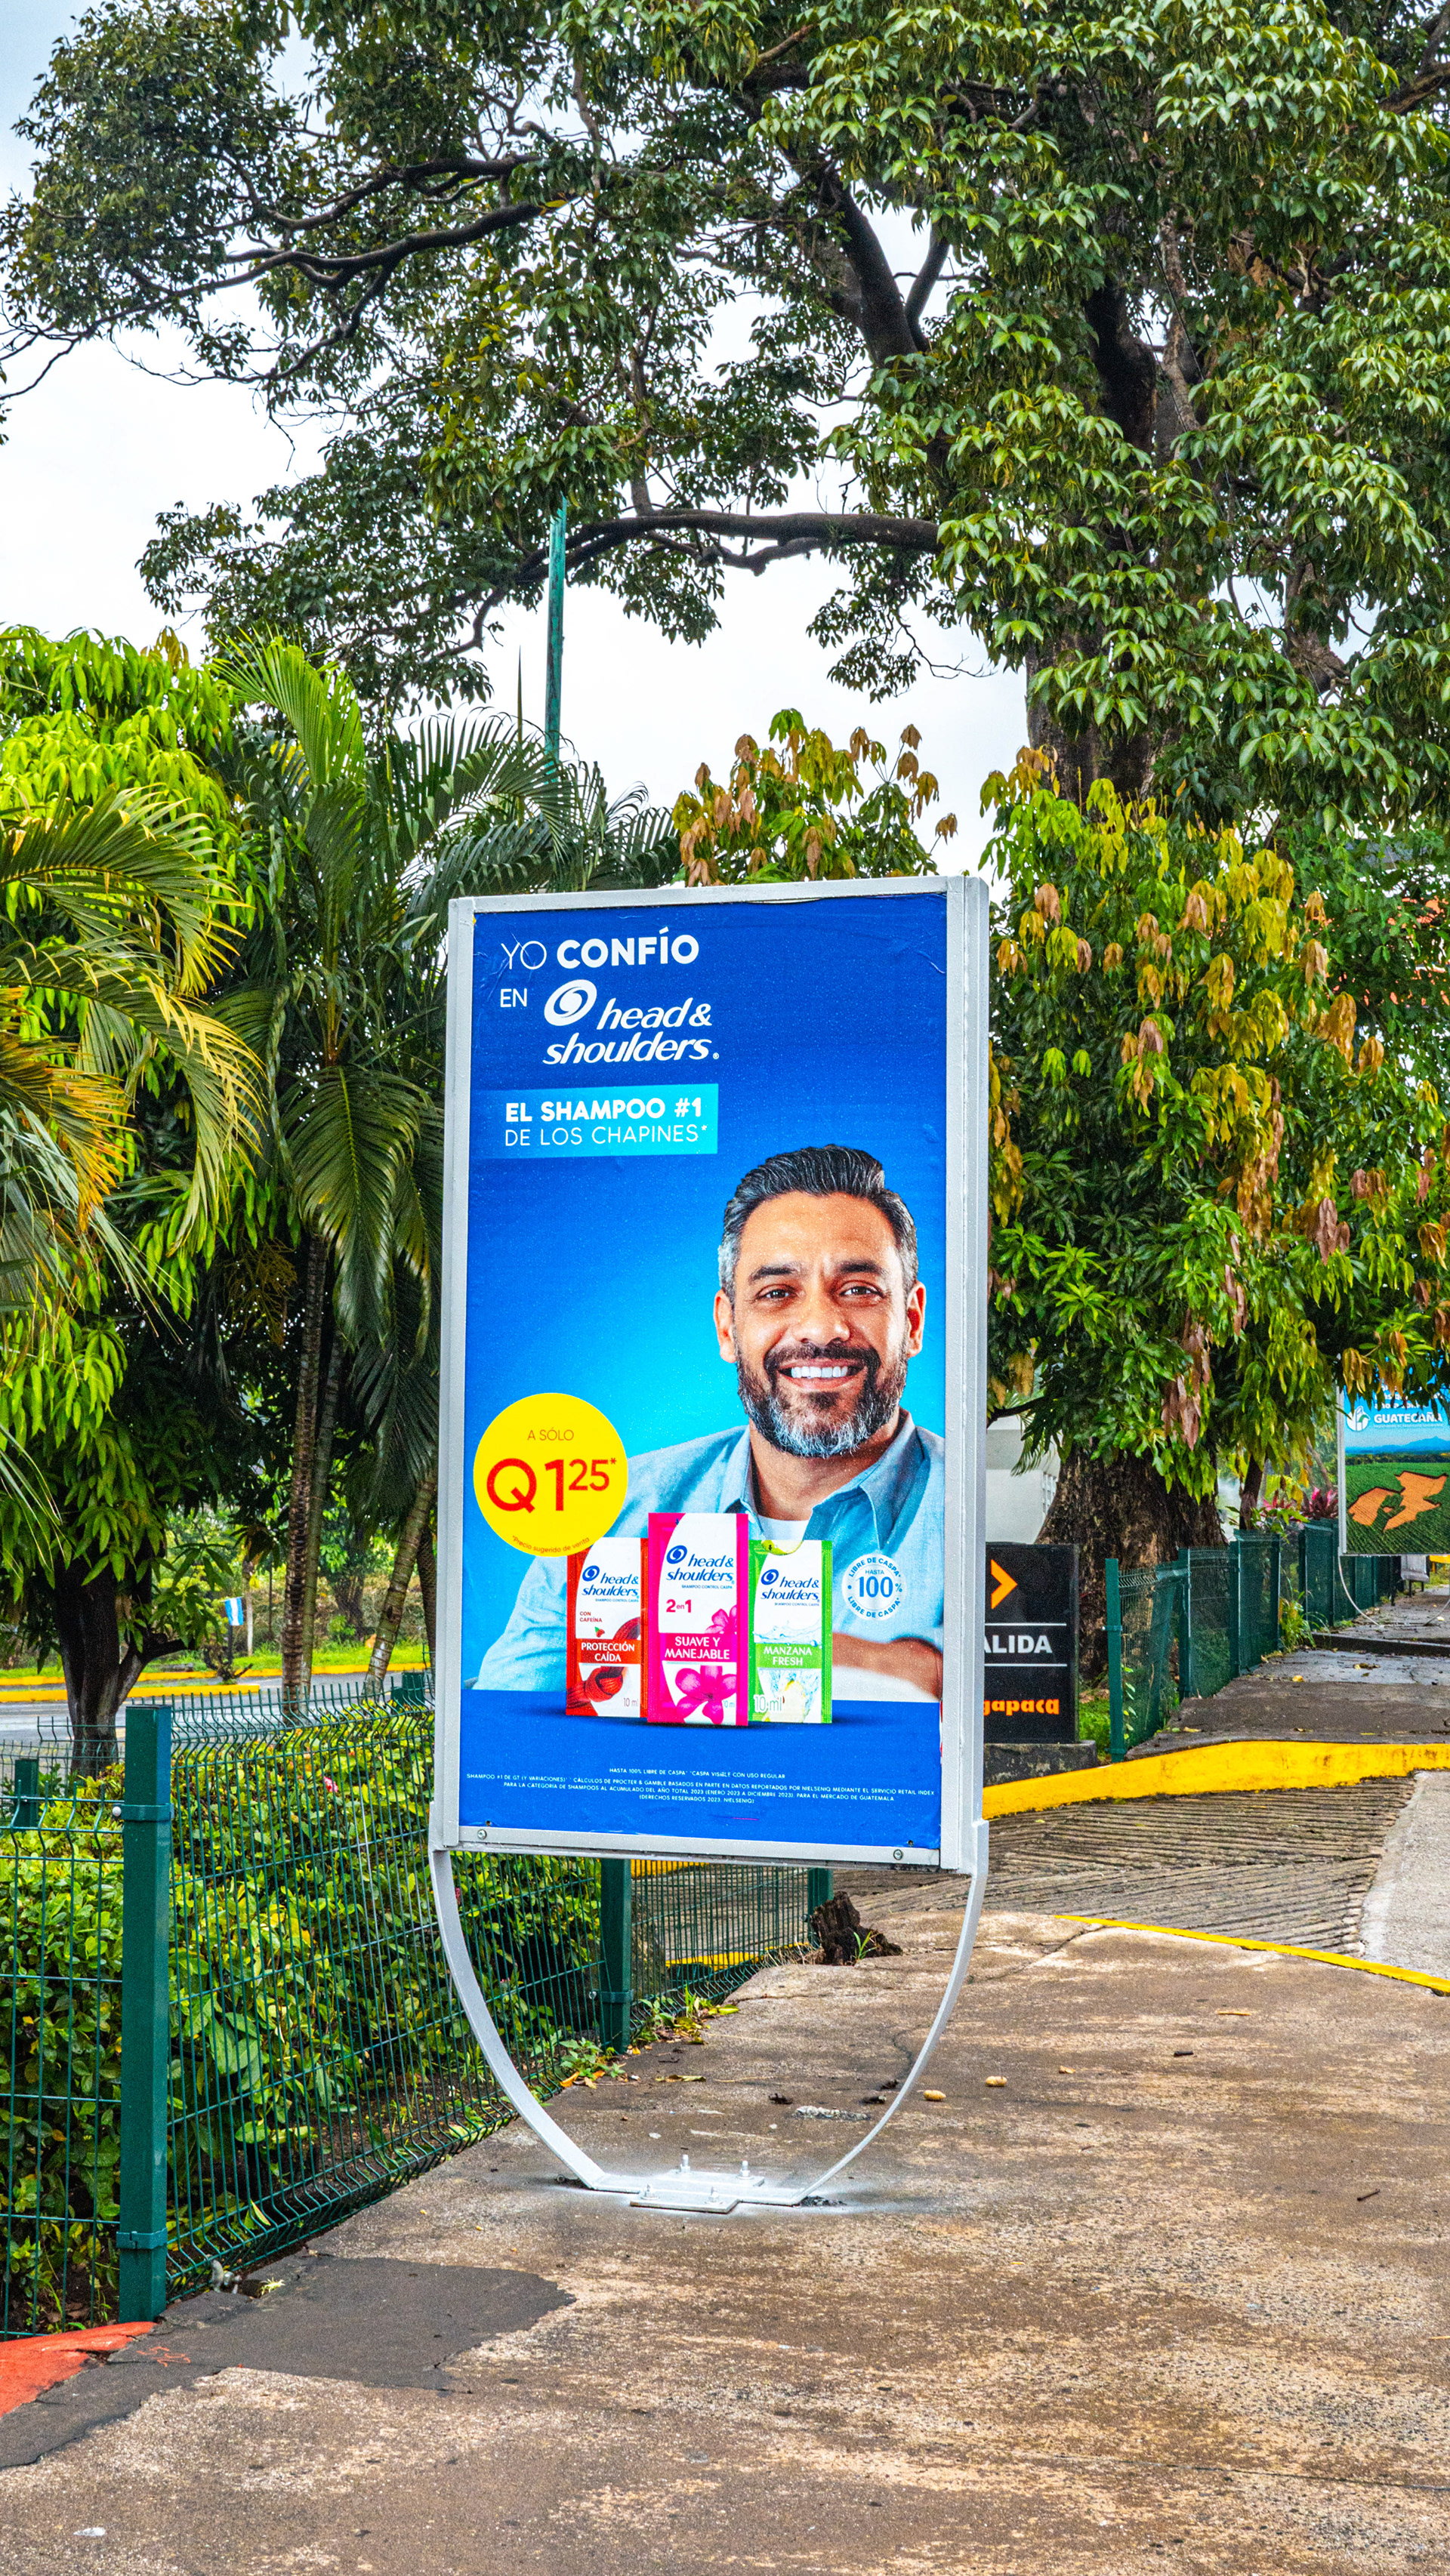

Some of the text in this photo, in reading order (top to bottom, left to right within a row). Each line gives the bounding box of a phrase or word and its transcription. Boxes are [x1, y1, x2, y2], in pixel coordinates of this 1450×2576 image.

[501, 927, 699, 969] YO CONFÍO
[500, 988, 527, 1008] EN
[506, 1098, 702, 1122] EL SHAMPOO #1
[505, 1129, 530, 1146] DE
[541, 1128, 582, 1145] LOS
[1374, 1412, 1442, 1423] GUATECAÑA
[528, 1427, 574, 1441] A SÓLO
[572, 1537, 590, 1548] venta
[849, 1560, 865, 1578] LIBRE
[848, 1597, 865, 1615] LIBRE
[582, 1641, 635, 1652] PROTECCIÓN
[675, 1636, 720, 1647] SUAVE Y
[595, 1651, 622, 1662] CAÍDA
[665, 1649, 730, 1659] MANEJABLE
[764, 1647, 812, 1656] MANZANA
[773, 1657, 803, 1665] FRESH
[624, 1698, 638, 1707] 10 ml
[754, 1696, 782, 1712] 10 ml
